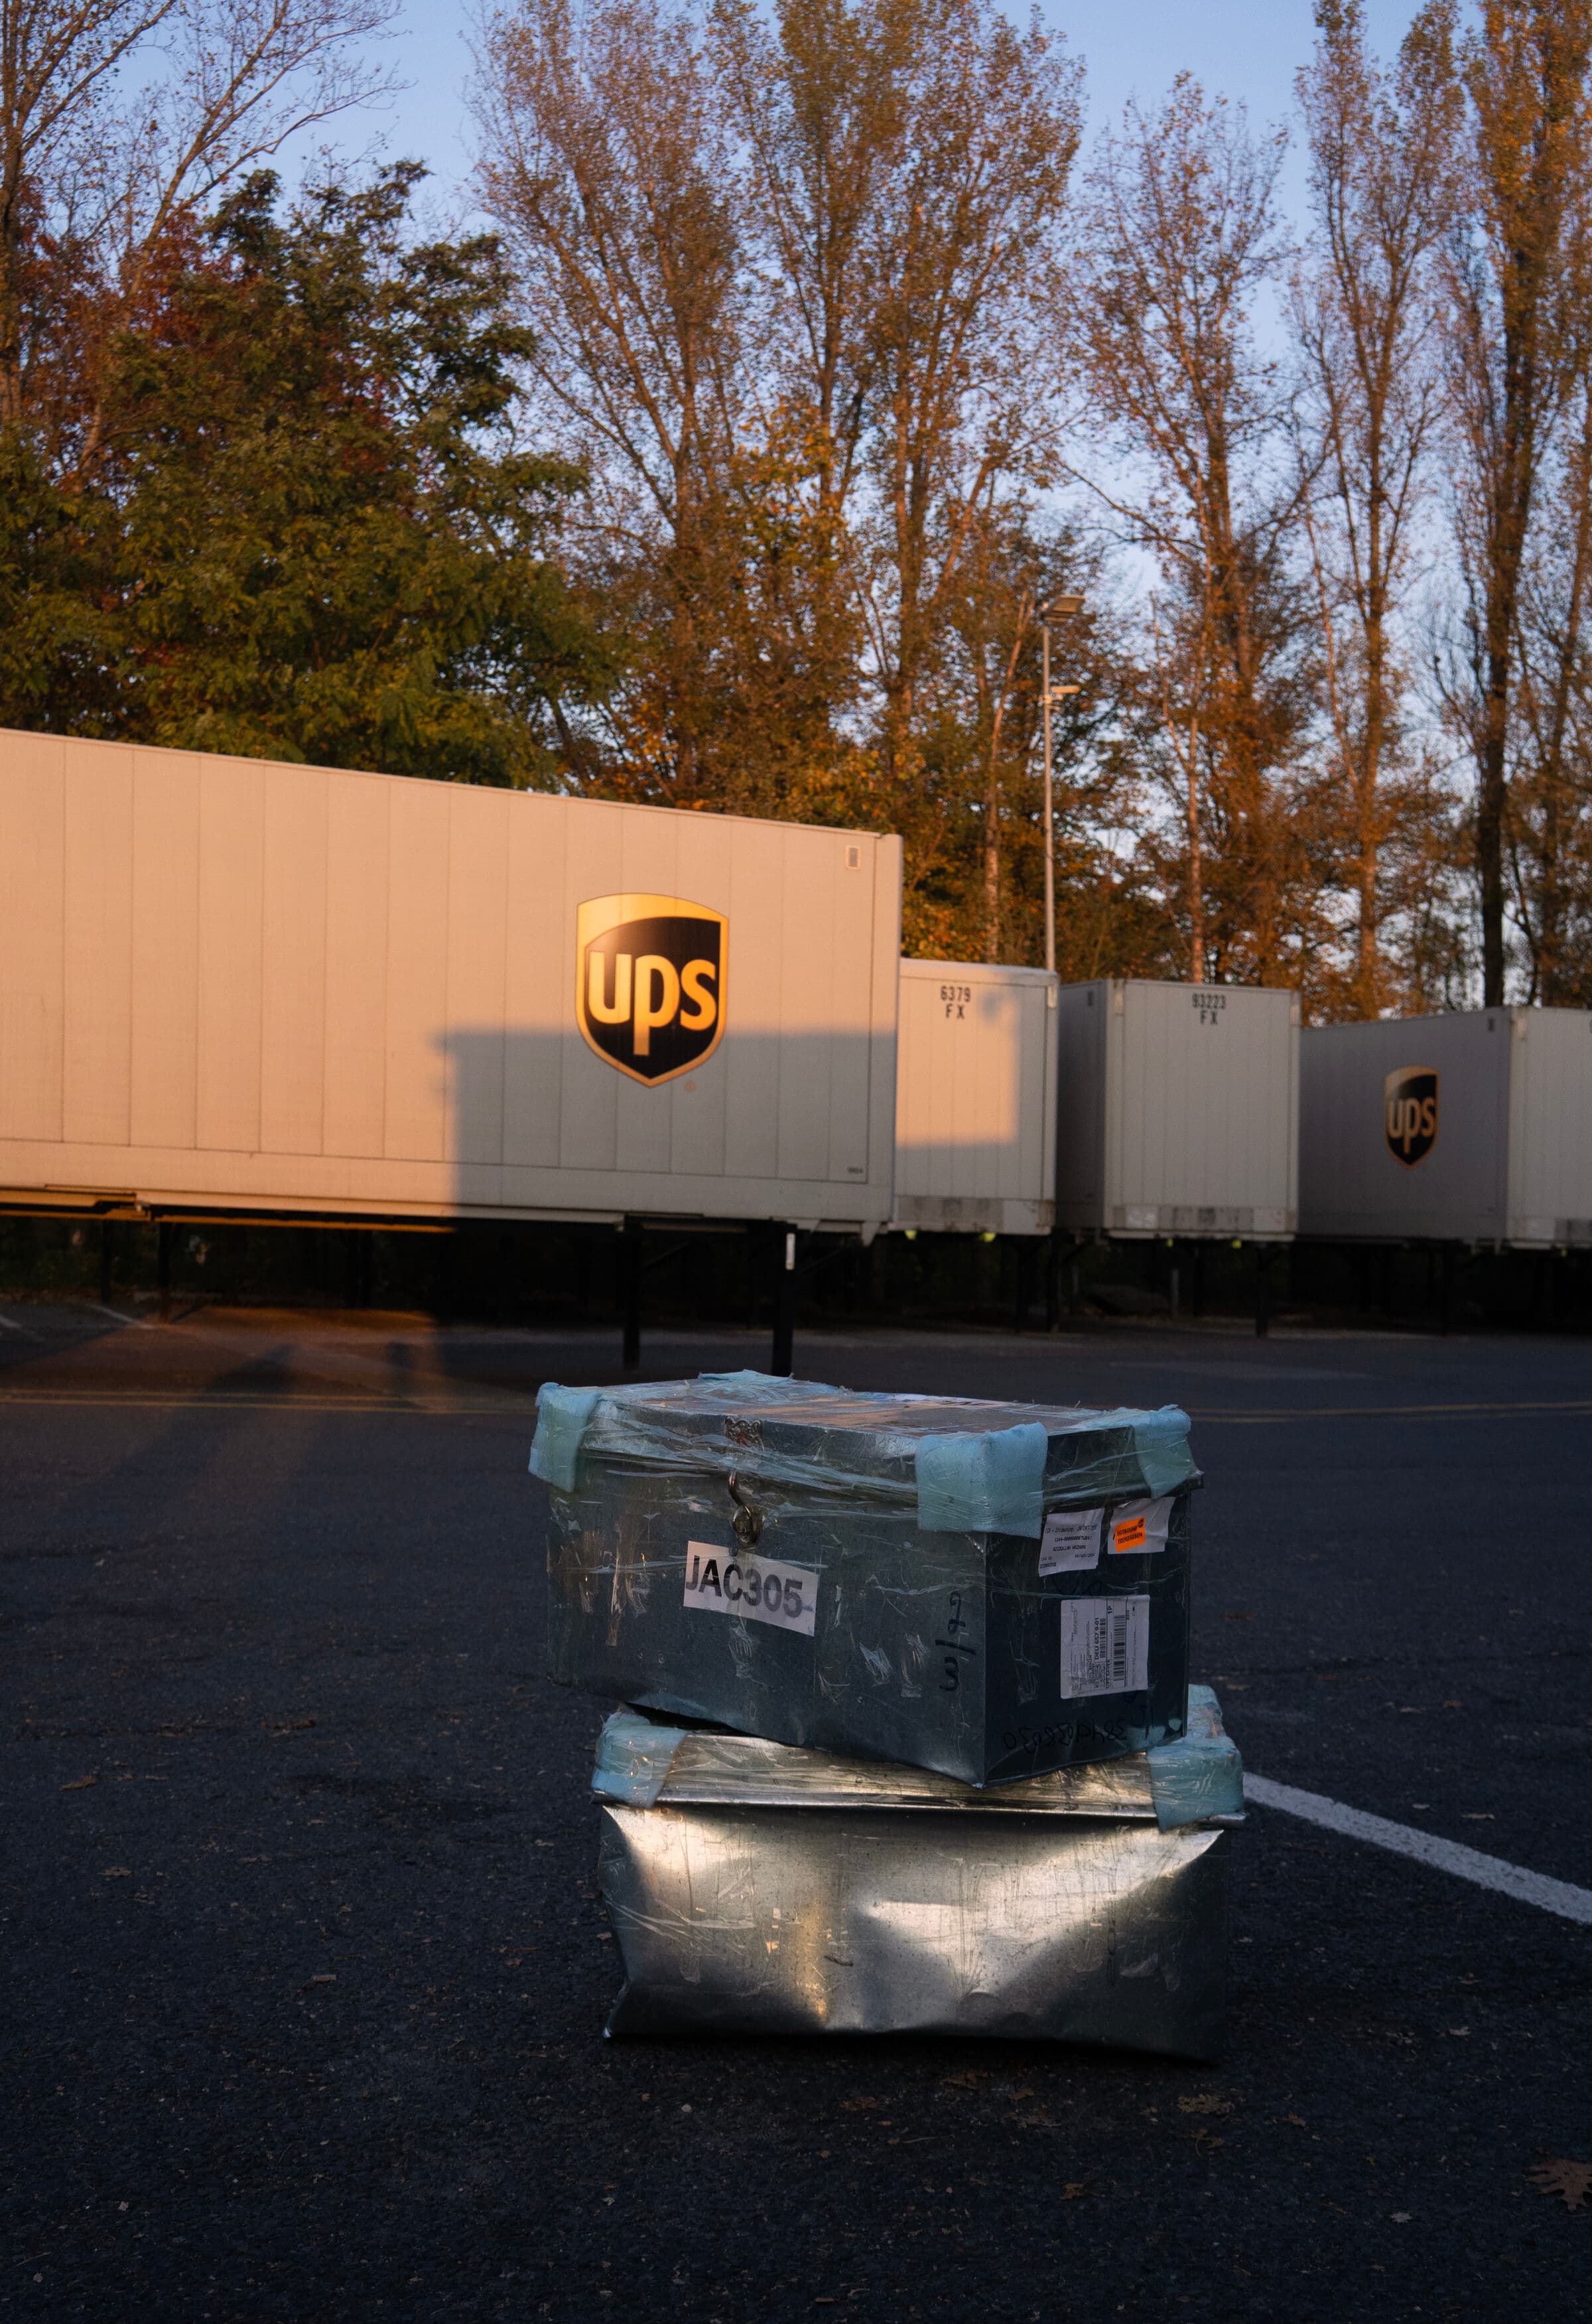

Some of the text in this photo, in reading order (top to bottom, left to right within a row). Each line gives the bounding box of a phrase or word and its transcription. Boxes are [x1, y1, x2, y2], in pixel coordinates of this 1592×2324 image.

[588, 950, 717, 1056] ups
[940, 985, 971, 1002] 6379
[1389, 1096, 1435, 1154] ups
